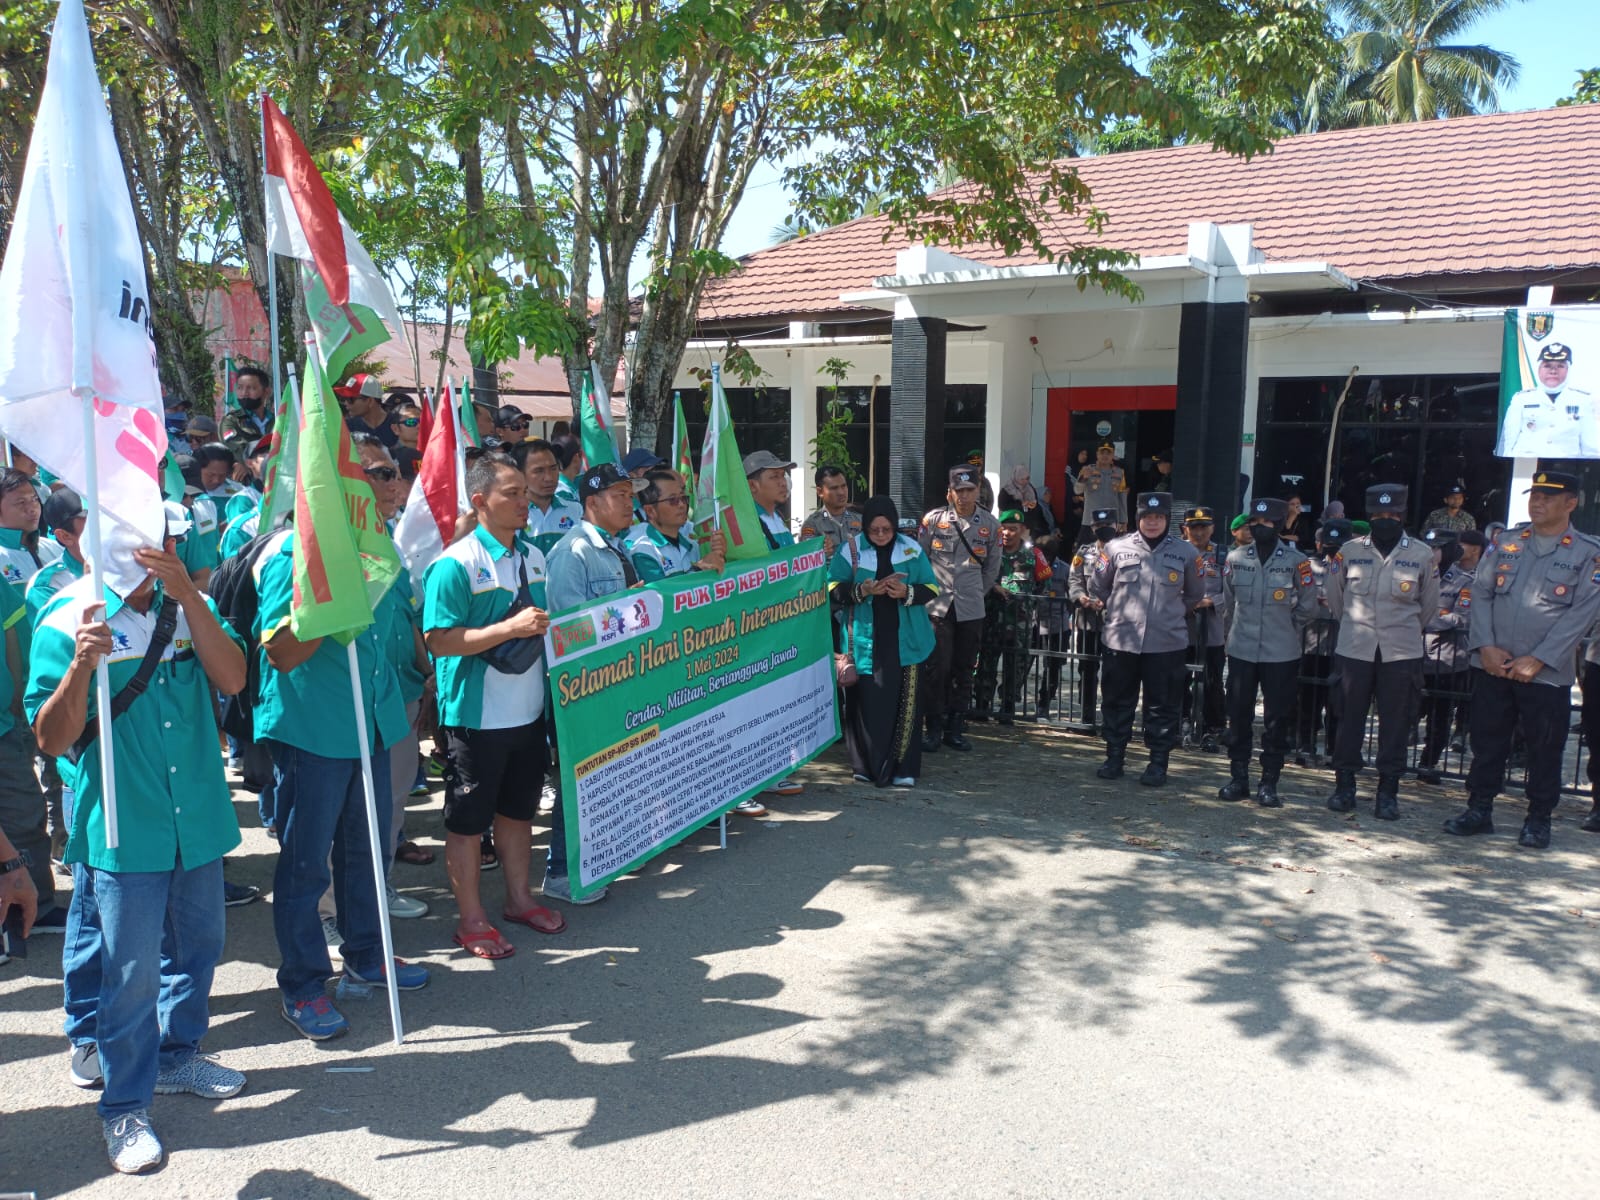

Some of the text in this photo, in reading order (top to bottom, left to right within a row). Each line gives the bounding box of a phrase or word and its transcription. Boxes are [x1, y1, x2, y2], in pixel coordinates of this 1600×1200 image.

[673, 583, 711, 613] PUK
[713, 576, 735, 601] SP
[737, 567, 765, 593] KEP
[767, 559, 788, 583] SIS
[1395, 560, 1420, 569] POLRI
[556, 580, 827, 707] Selamat Hari Buruh Internasional
[685, 643, 739, 680] 1 Mei 2024
[623, 641, 798, 732] Cerdas, Militan, Bertanggung Jawab
[576, 727, 656, 777] TUNTUTAN SP-KEP SIS ADMO
[585, 769, 603, 788] CABUT
[692, 718, 707, 732] CIPTA
[708, 710, 725, 725] KERJA
[618, 759, 647, 783] SOURCING
[648, 753, 660, 766] DAN
[589, 785, 624, 814] KEMBALIKAN
[625, 770, 653, 792] MEDIATOR
[589, 802, 619, 827] DISNAKER
[620, 784, 650, 808] TABALONG
[591, 813, 623, 840] KARYAWAN
[643, 791, 660, 808] ADMO
[590, 846, 613, 865] MINTA
[591, 845, 636, 877] DEPARTEMEN
[592, 829, 621, 852] TERLALU
